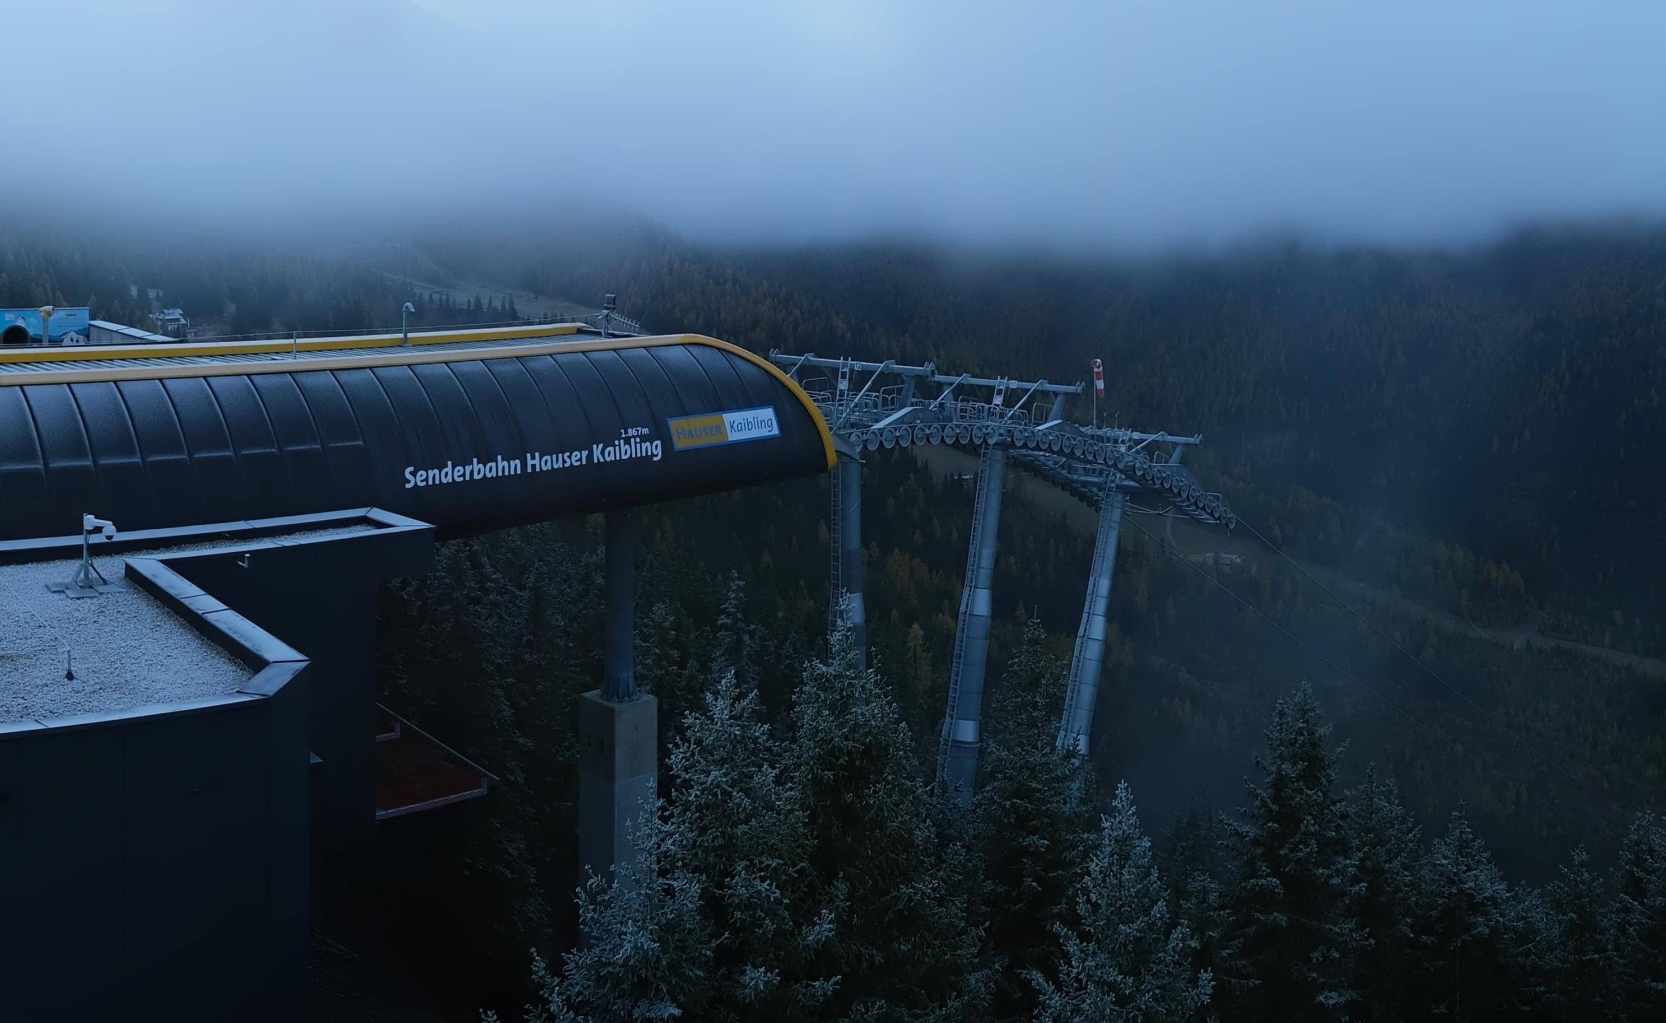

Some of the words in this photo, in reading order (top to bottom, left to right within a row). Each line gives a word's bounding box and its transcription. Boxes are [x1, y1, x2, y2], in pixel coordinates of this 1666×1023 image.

[620, 427, 650, 438] 1.867m
[729, 417, 774, 433] Kaibling
[404, 455, 522, 489] Senderbahn
[526, 449, 589, 474] Hauser
[592, 437, 663, 464] Kaibling
